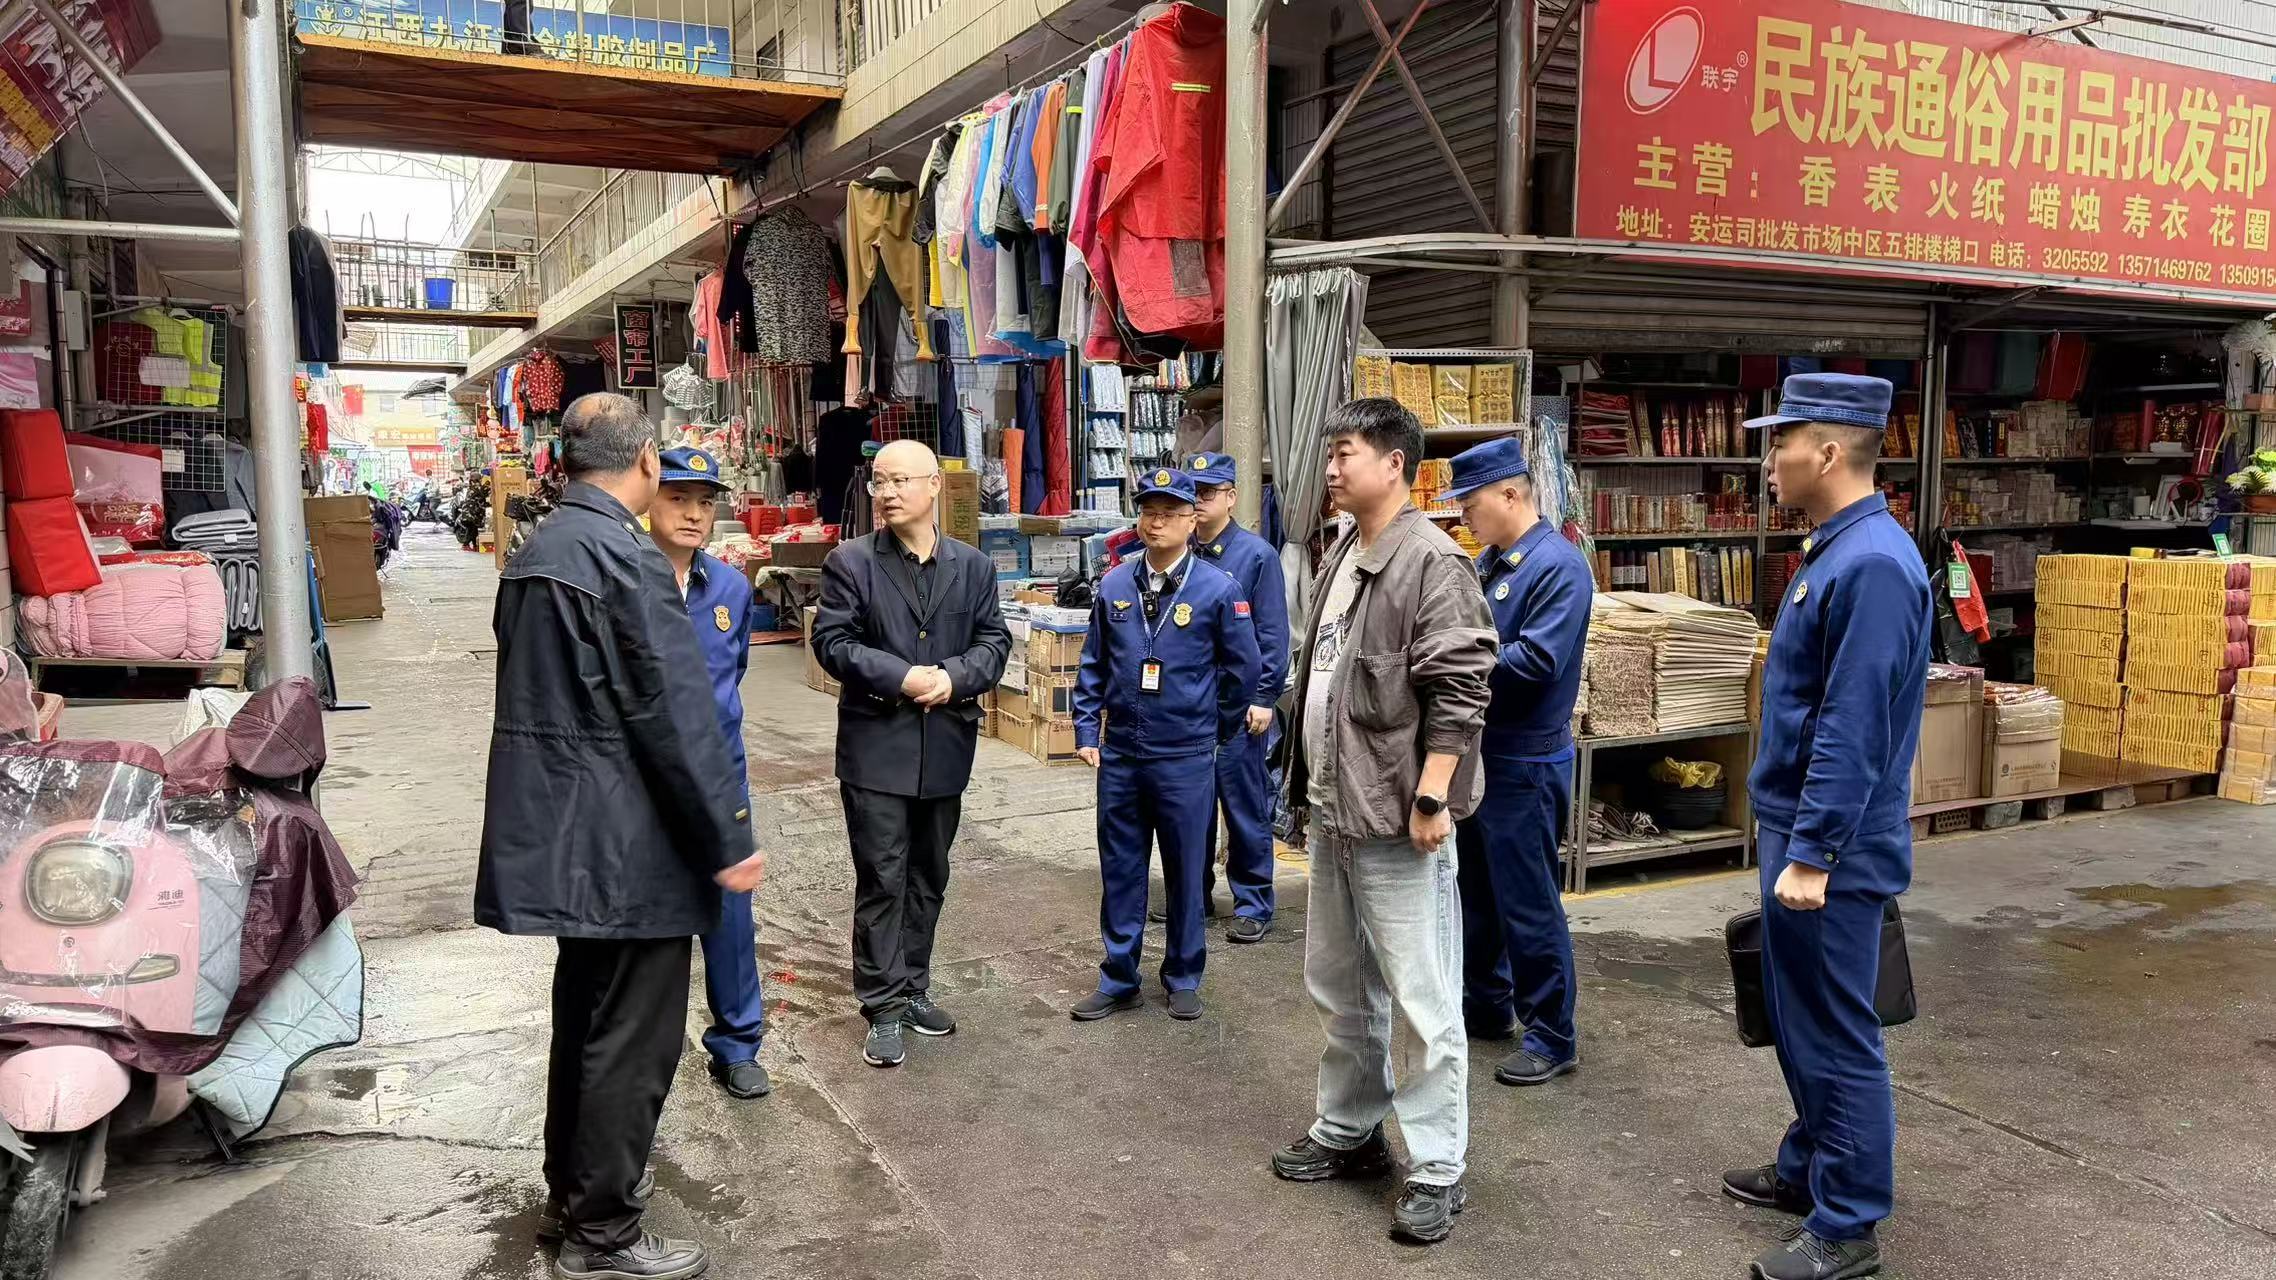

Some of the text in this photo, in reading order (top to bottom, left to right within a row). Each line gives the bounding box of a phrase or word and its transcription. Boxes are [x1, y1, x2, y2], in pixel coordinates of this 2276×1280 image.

[358, 8, 717, 73] 江西九江金塑胶制品厂
[1701, 64, 1739, 92] 联宇
[1751, 15, 2271, 200] 民族通俗用品批发部
[1688, 211, 1979, 264] 安运司批发市场中区五排楼梯口
[2042, 247, 2109, 274] 3205592
[2117, 254, 2212, 283] 13571469762
[2219, 263, 2276, 288] 1350915
[2028, 181, 2102, 234] 蜡烛
[2122, 193, 2190, 242] 寿衣
[2208, 203, 2272, 252] 花圈
[622, 310, 653, 384] 窗帘工厂
[157, 889, 185, 901] 雅迪
